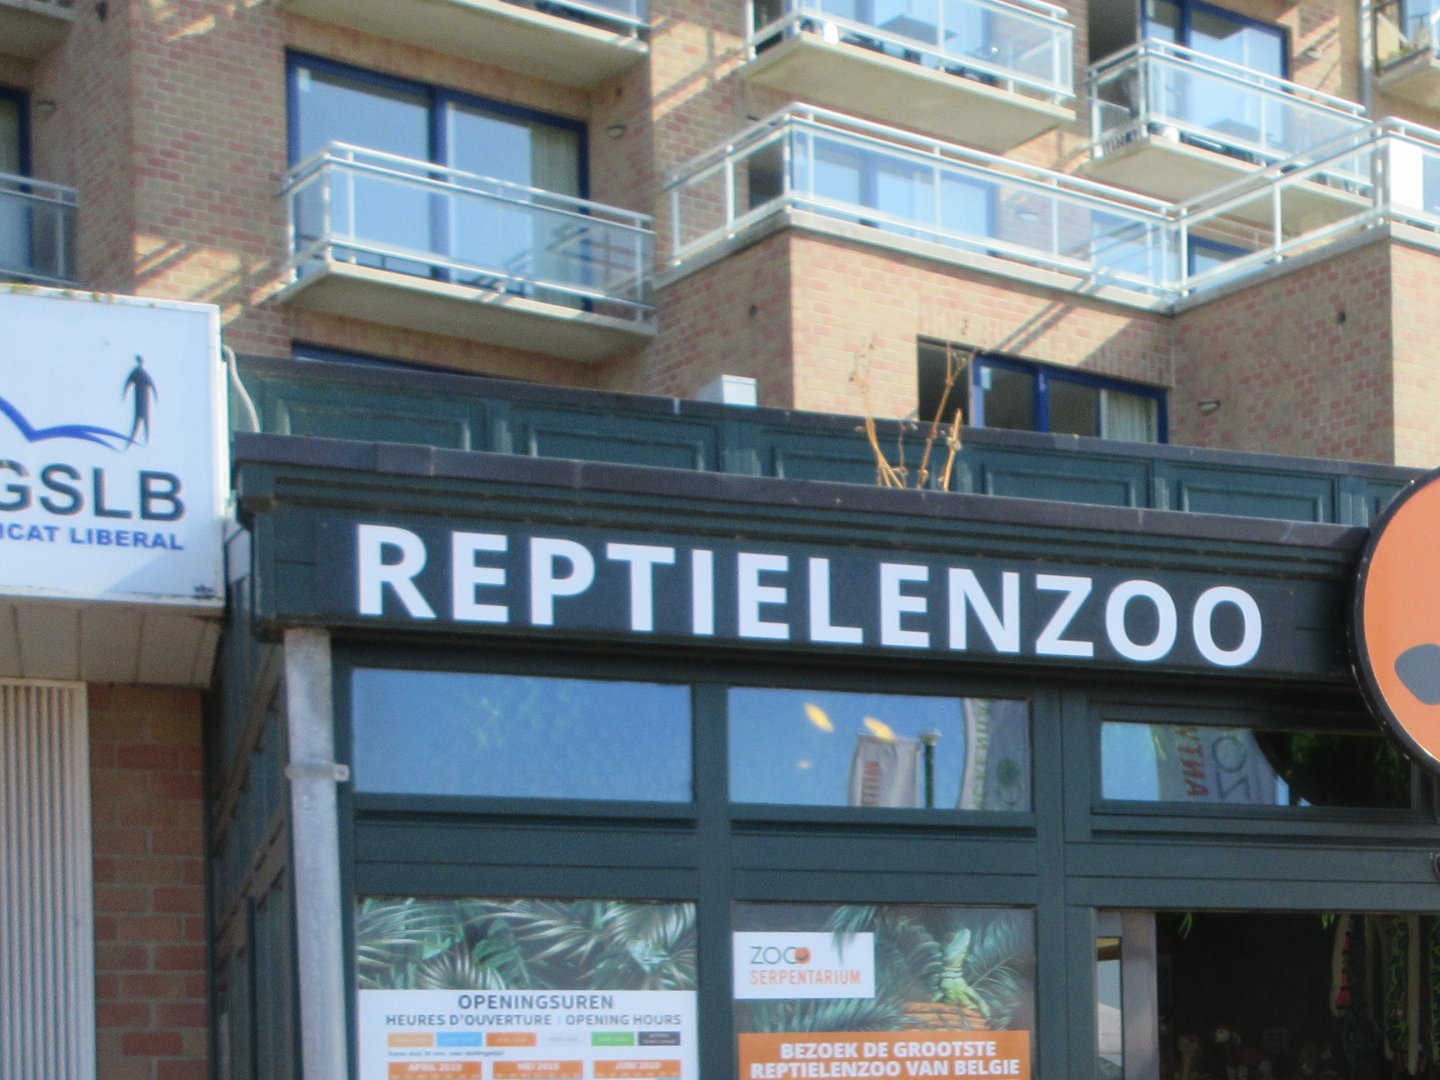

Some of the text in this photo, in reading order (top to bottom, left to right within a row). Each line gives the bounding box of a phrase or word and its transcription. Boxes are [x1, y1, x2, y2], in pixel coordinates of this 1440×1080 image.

[70, 527, 184, 550] LIBERAL
[357, 523, 1262, 667] REPTIELENZOO
[750, 969, 862, 985] SERPENTARIUM
[458, 994, 614, 1010] OPENINGSUREN
[386, 1014, 681, 1026] HEURES D'OUVERTURE OPENING HOURS
[781, 1041, 996, 1059] BEZOEK DE GROOTSTE
[407, 1062, 435, 1073] APRIL
[751, 1059, 1020, 1079] REPTIELENZOO VAN BELGIE
